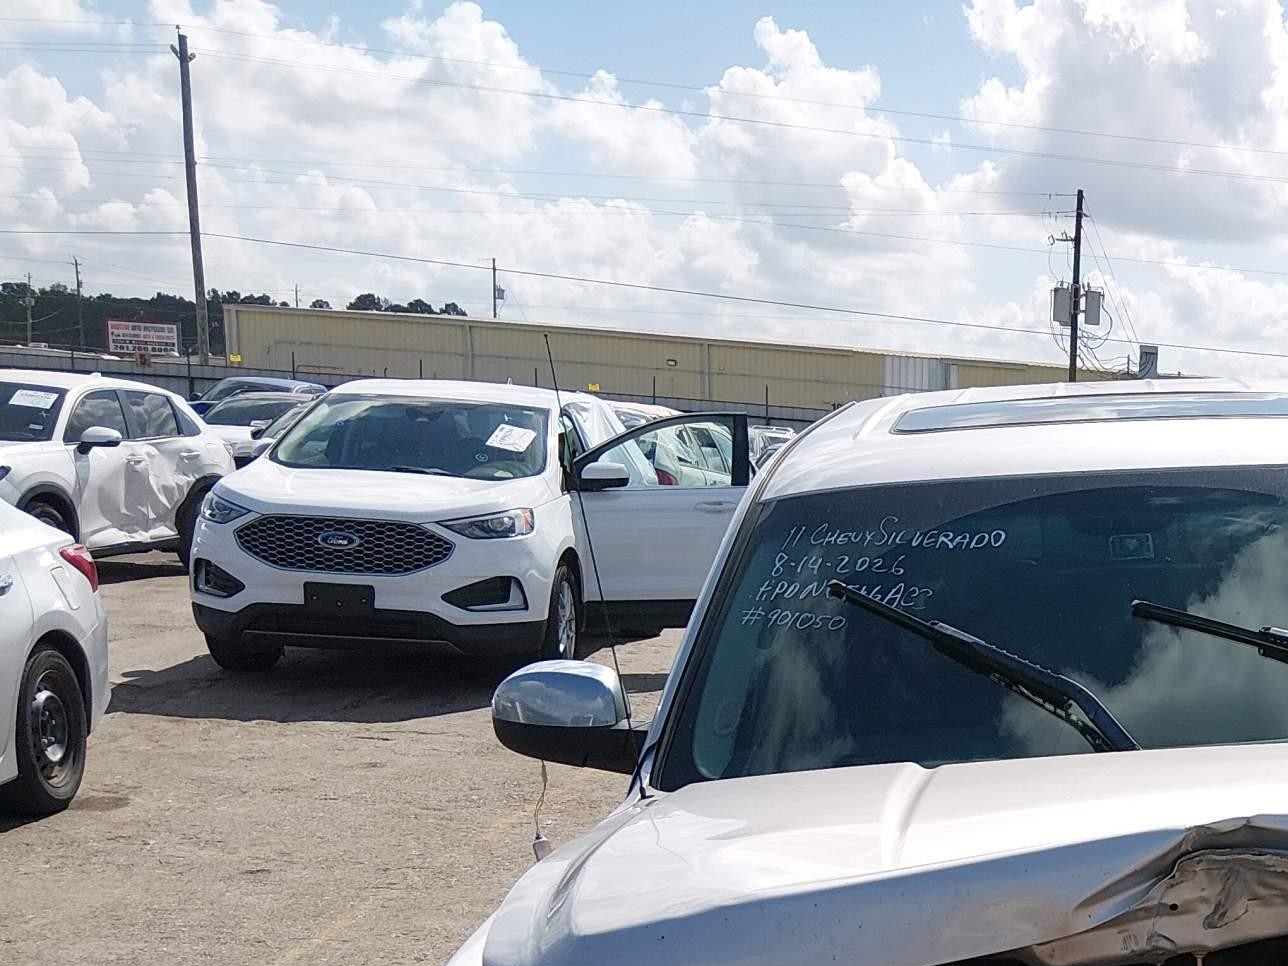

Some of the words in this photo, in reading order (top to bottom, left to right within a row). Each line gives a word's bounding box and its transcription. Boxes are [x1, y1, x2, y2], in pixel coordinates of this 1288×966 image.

[810, 523, 876, 547] CHEVY
[874, 516, 1006, 549] SILVERADO
[771, 552, 906, 577] 8-14-2026
